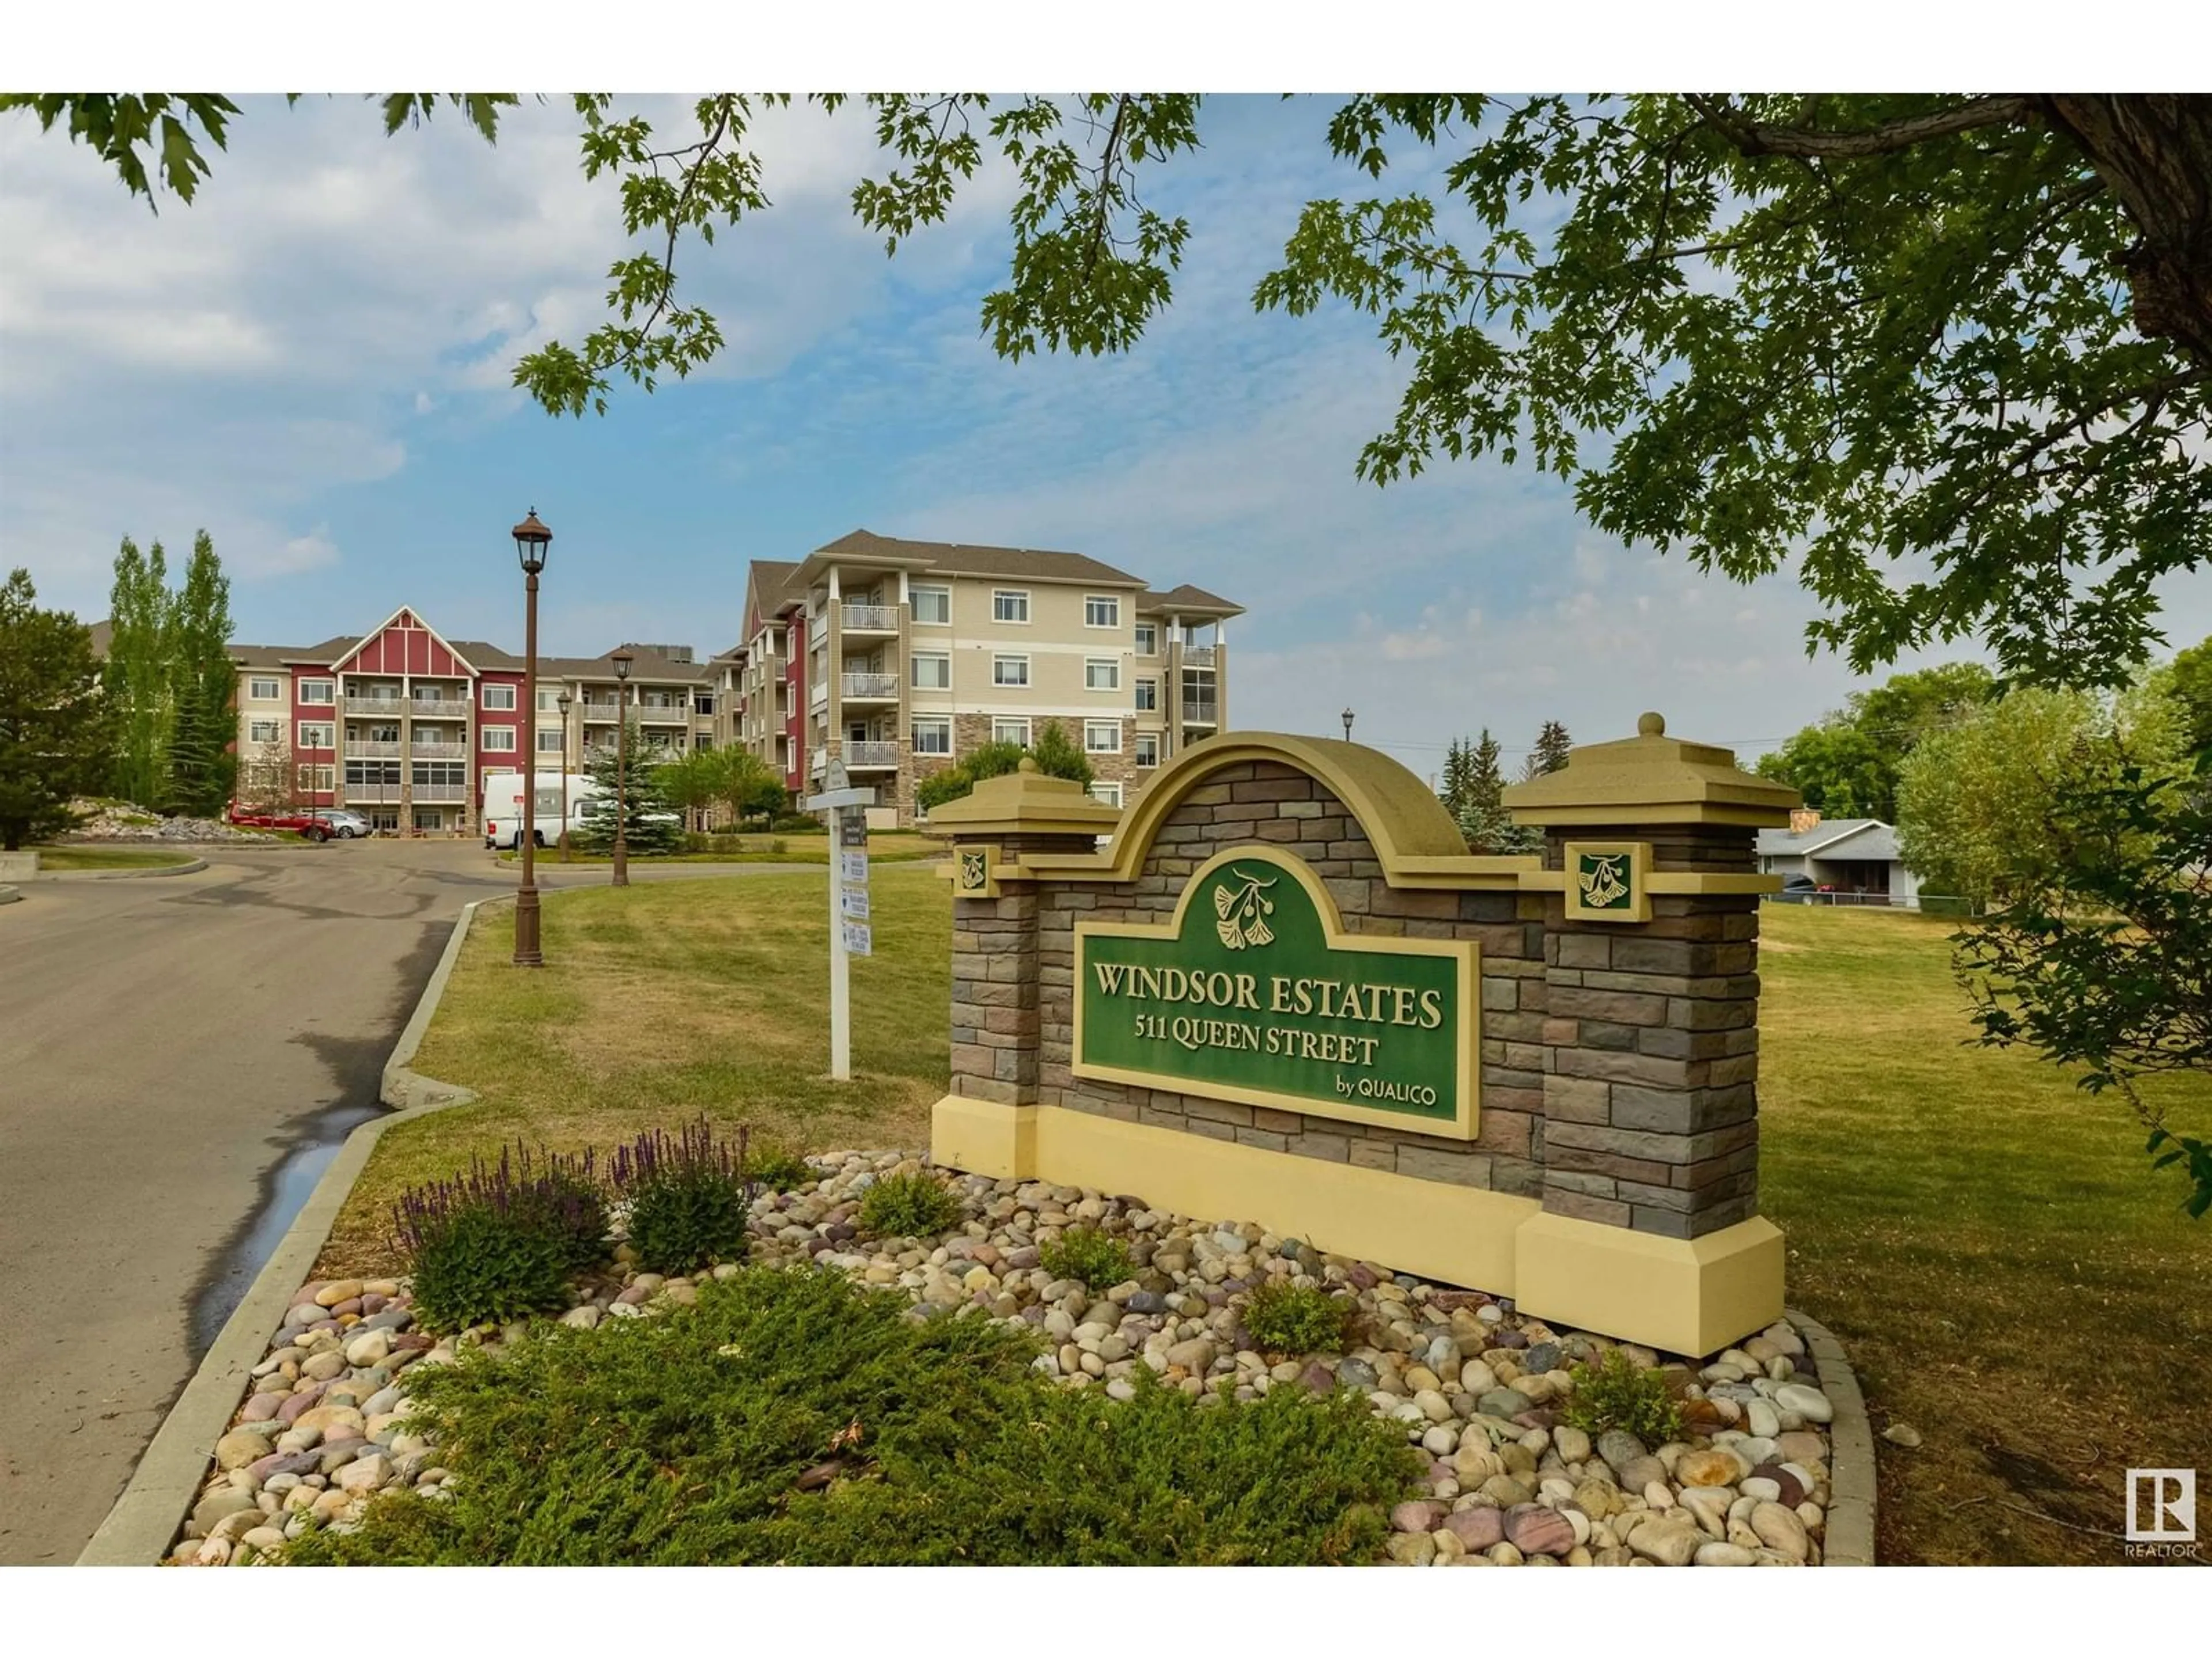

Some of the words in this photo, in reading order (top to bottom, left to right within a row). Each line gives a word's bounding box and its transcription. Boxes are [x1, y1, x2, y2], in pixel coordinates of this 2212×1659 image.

[1093, 962, 1261, 1010] WINDSOR
[1269, 977, 1442, 1029] ESTATES
[1134, 1014, 1167, 1039] 511
[1172, 1017, 1261, 1052] QUEEN
[1266, 1027, 1379, 1066] STREET
[1336, 1074, 1354, 1098] by
[1358, 1078, 1437, 1106] QUALICO
